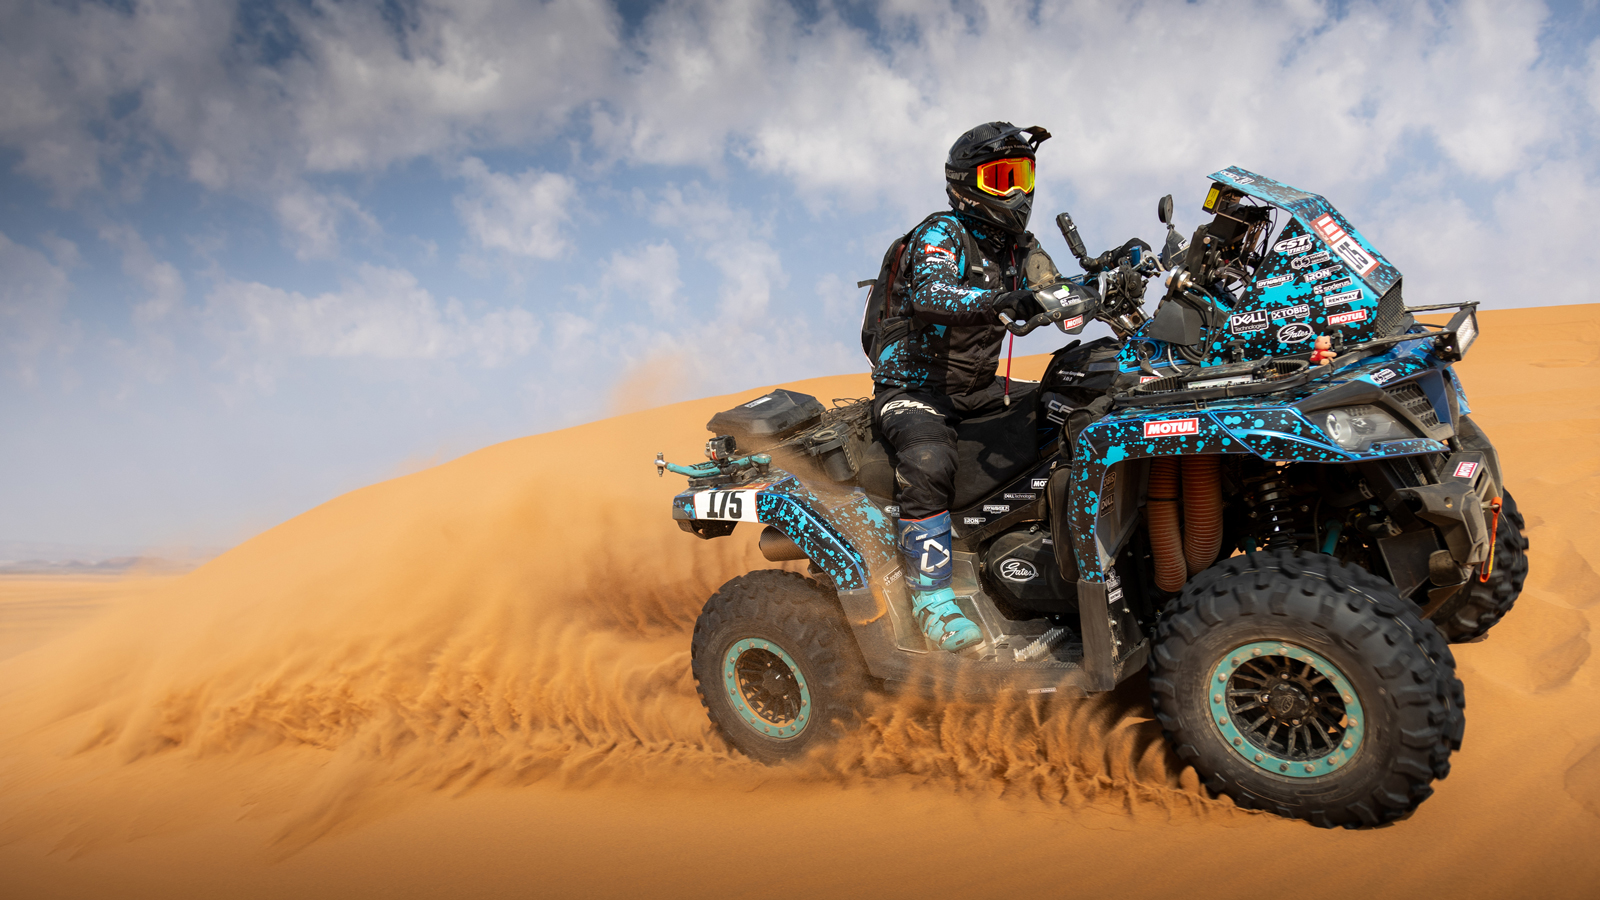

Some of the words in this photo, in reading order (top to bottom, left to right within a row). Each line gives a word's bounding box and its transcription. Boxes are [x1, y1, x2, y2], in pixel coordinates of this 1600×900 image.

[1276, 236, 1310, 251] CST
[1288, 245, 1311, 255] TIRES
[1337, 241, 1369, 270] 175
[1305, 270, 1331, 282] IRON
[1328, 293, 1356, 303] RENTWAY
[1232, 312, 1265, 326] DELL
[1331, 312, 1364, 325] MOTUL
[1234, 322, 1267, 334] Technologies
[1280, 326, 1308, 342] Gates
[1147, 421, 1195, 435] MOTUL
[707, 490, 746, 519] 175
[1003, 562, 1032, 578] Gates
